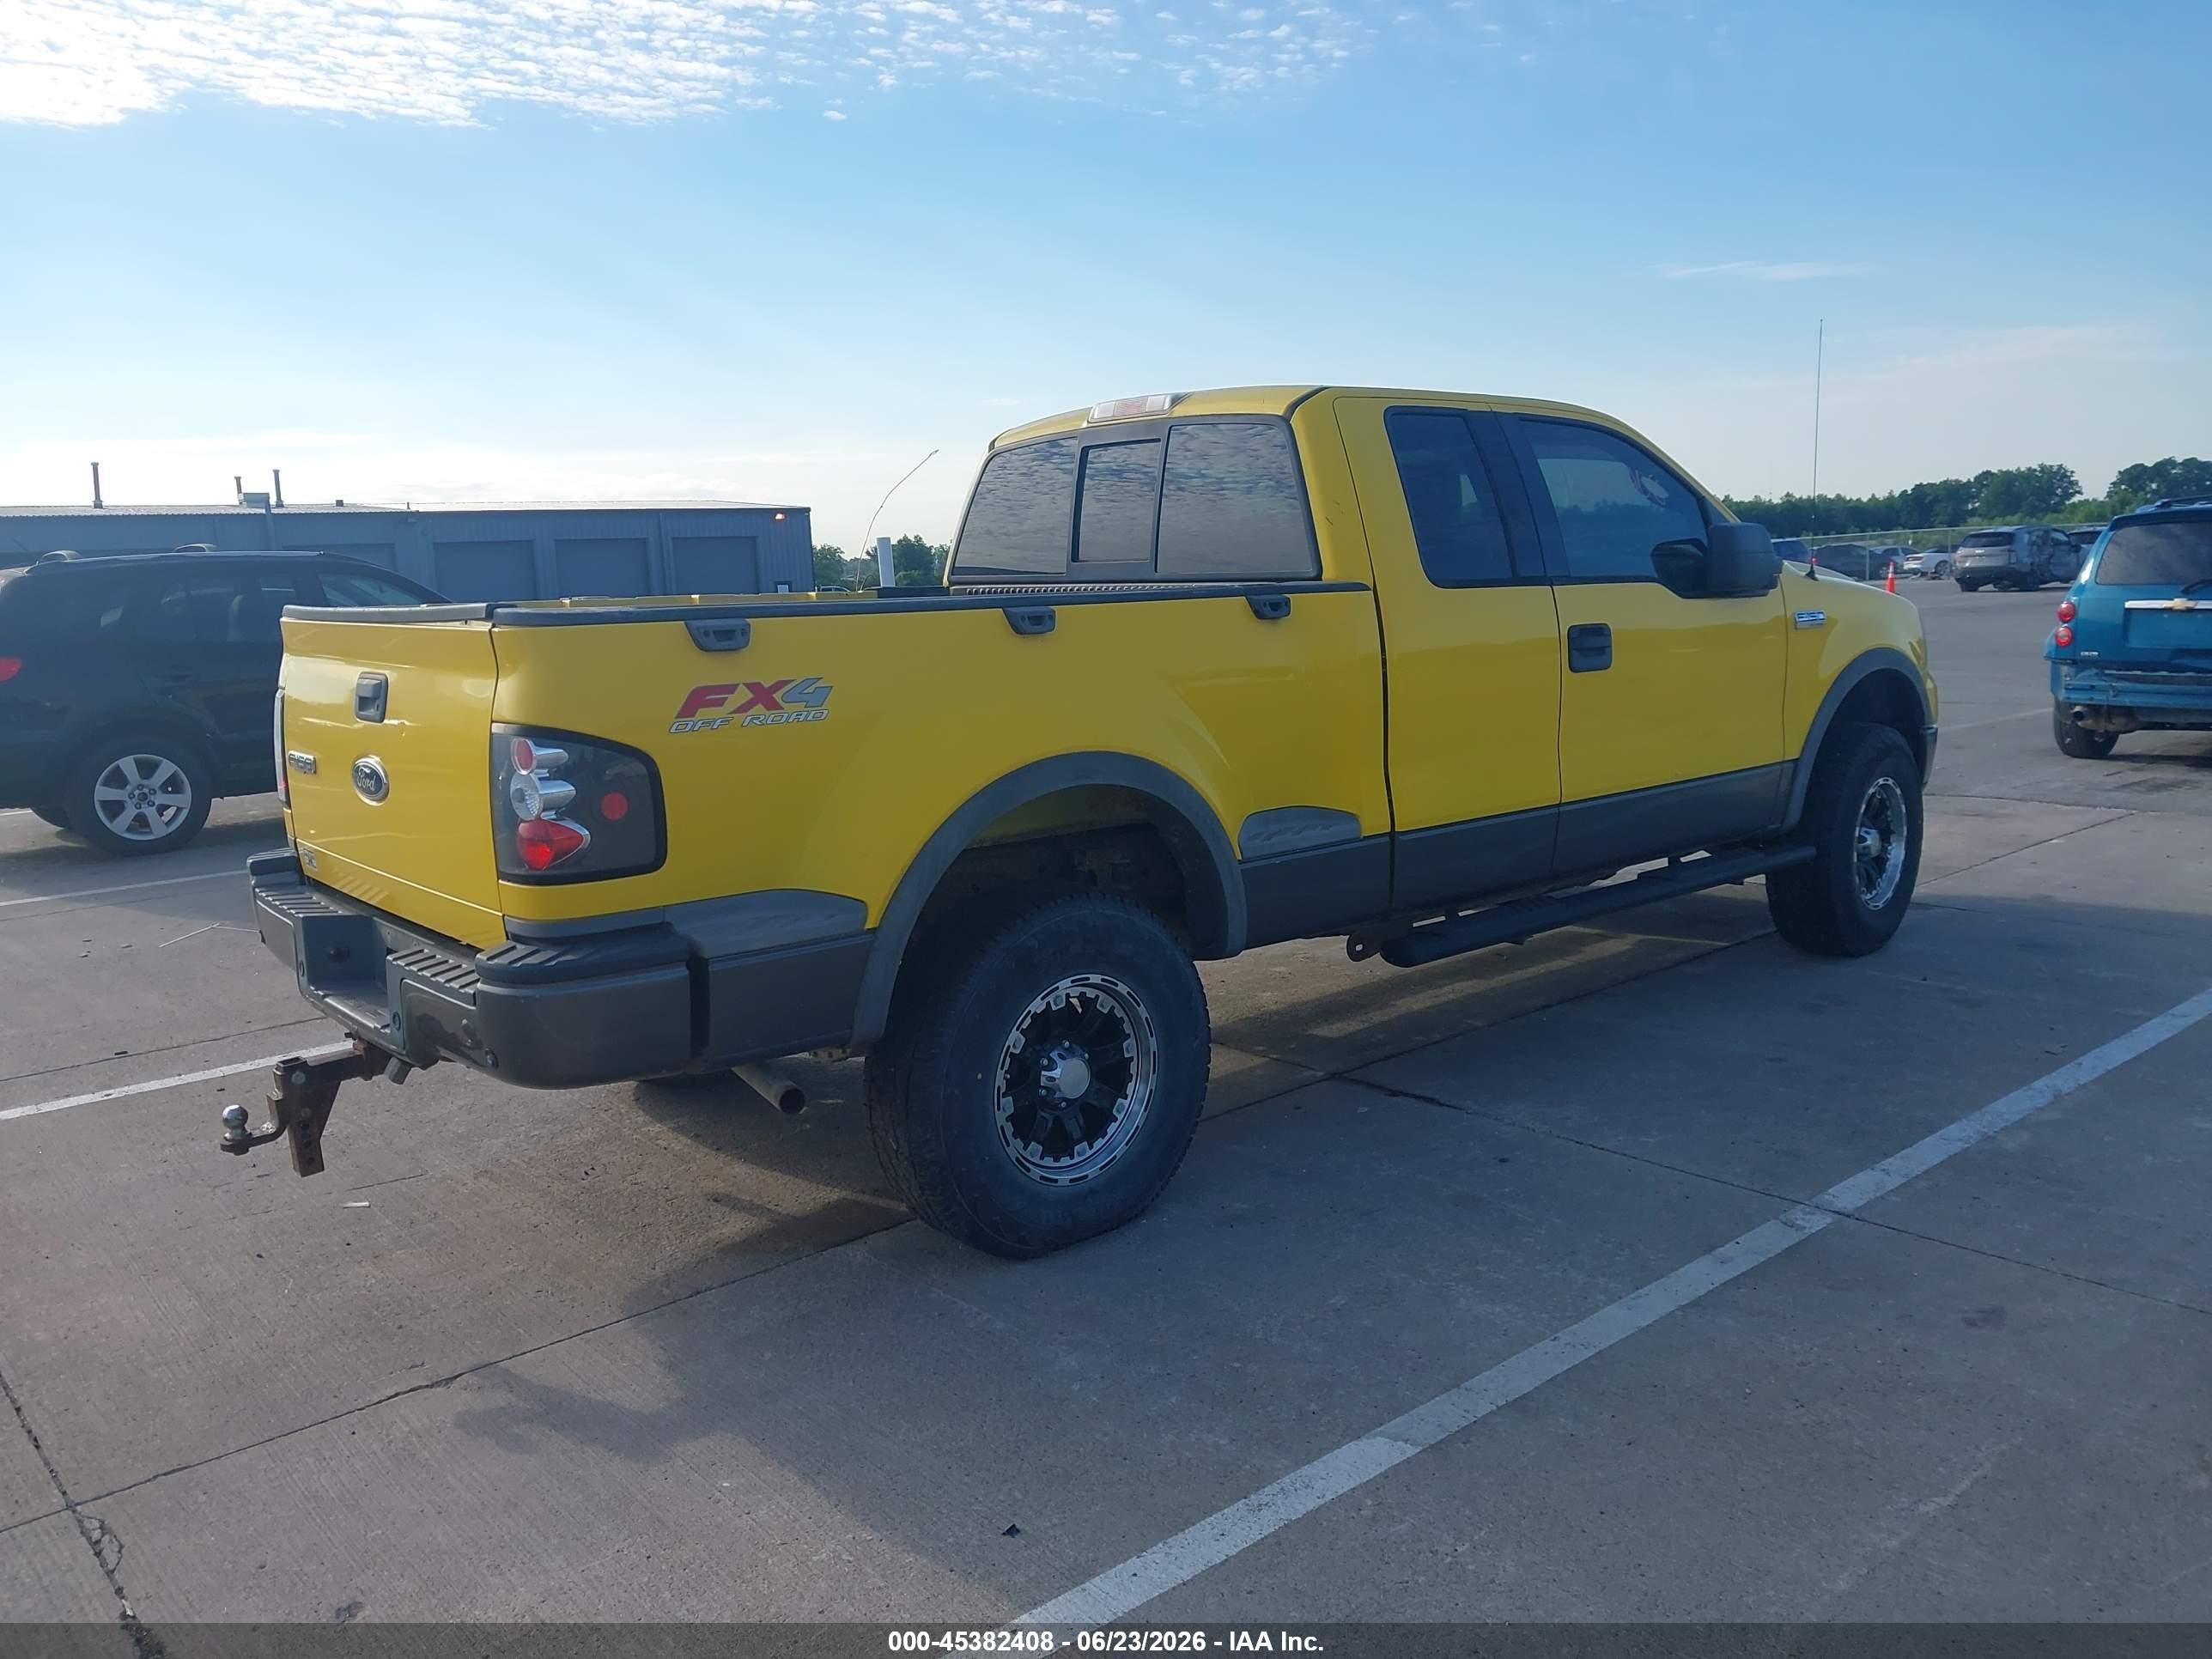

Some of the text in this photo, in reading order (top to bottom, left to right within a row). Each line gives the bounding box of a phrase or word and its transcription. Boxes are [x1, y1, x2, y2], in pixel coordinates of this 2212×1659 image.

[675, 678, 834, 720] FX4
[669, 708, 830, 734] OFF ROAD
[357, 766, 376, 791] Ford
